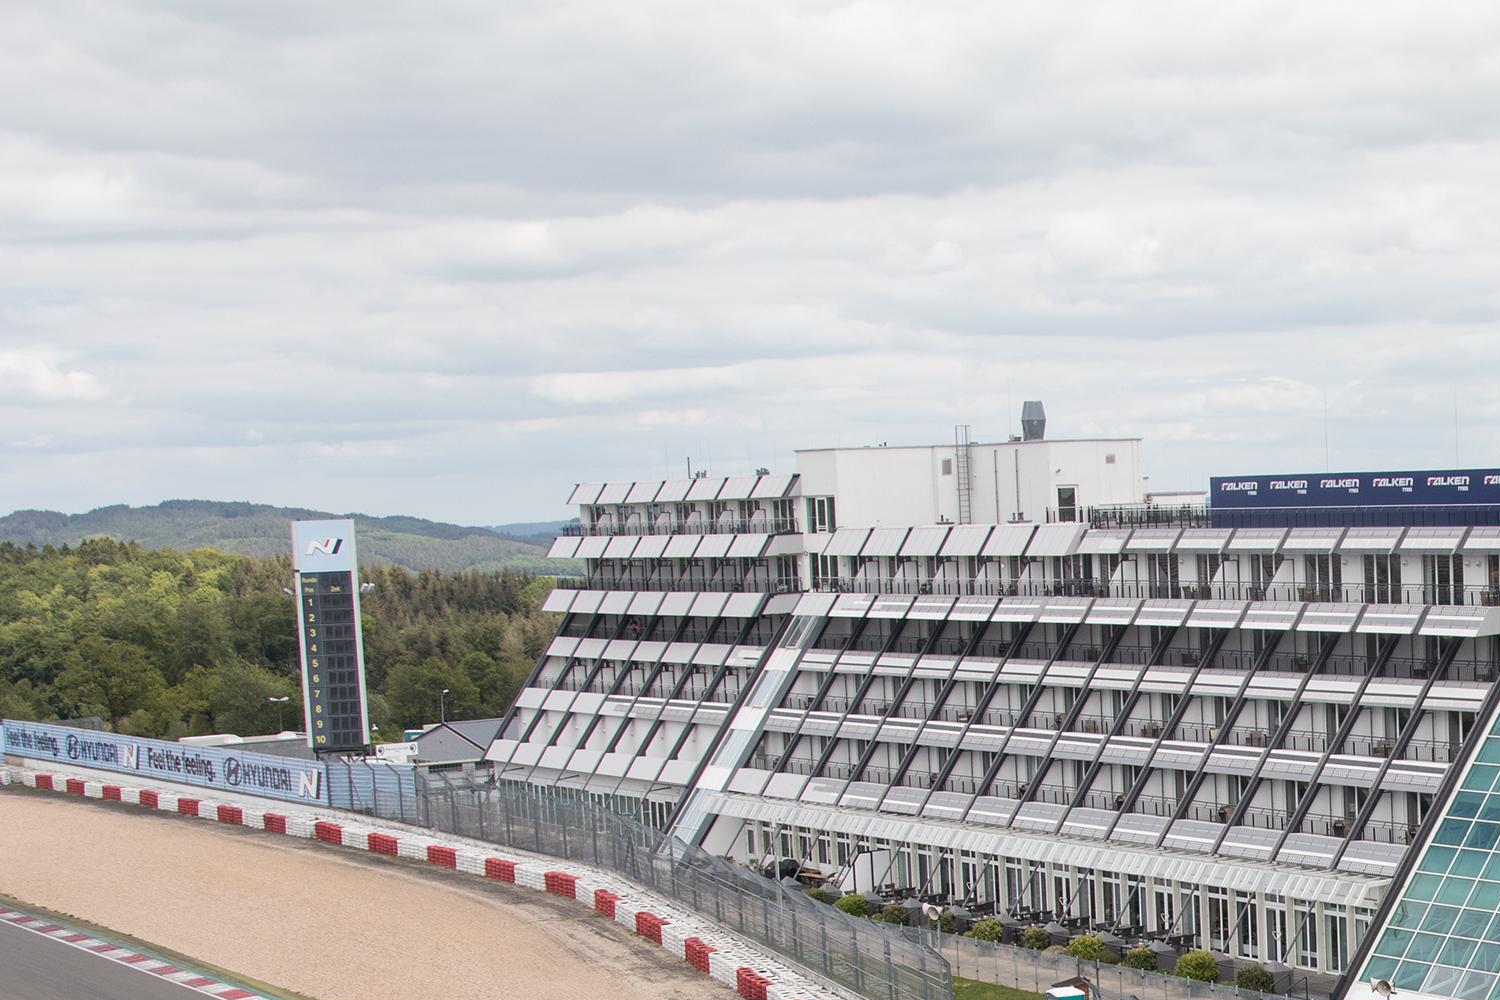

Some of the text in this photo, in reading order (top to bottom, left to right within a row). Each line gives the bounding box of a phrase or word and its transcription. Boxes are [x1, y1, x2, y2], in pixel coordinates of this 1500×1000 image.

[1270, 480, 1307, 489] FALKEN
[1320, 479, 1359, 488] FALKEN
[1373, 477, 1413, 487] FALKEN
[1427, 476, 1469, 486] FALKEN
[1221, 482, 1257, 490] FALKEN
[308, 598, 313, 607] 1
[308, 613, 316, 622] 2
[310, 629, 316, 637] 3
[311, 644, 317, 652] 4
[312, 660, 319, 668] 5
[313, 674, 320, 683] 6
[314, 690, 320, 698] 7
[315, 705, 322, 713] 8
[316, 720, 323, 729] 9
[316, 735, 326, 744] 10
[80, 740, 119, 763] HYUNDAI
[148, 748, 165, 770] Feel
[166, 750, 181, 773] the
[242, 763, 292, 791] HYUNDAI
